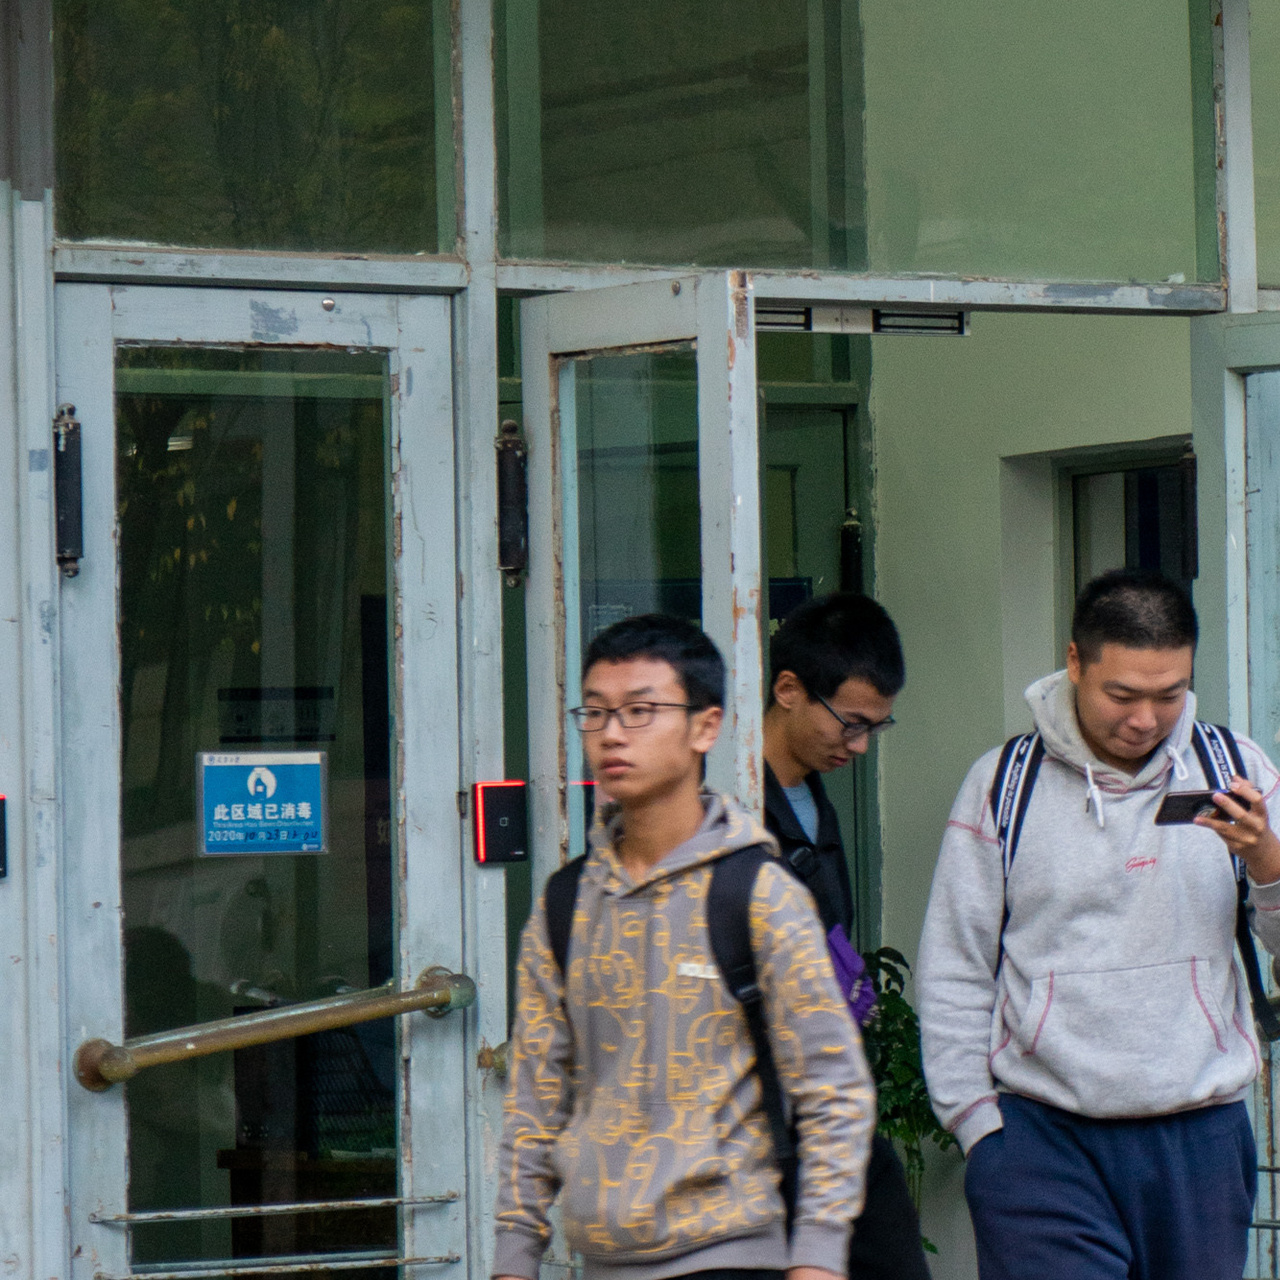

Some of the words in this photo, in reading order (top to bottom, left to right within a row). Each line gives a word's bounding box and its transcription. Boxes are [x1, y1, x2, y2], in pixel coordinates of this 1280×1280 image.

[214, 802, 312, 820] 此区域已消毒
